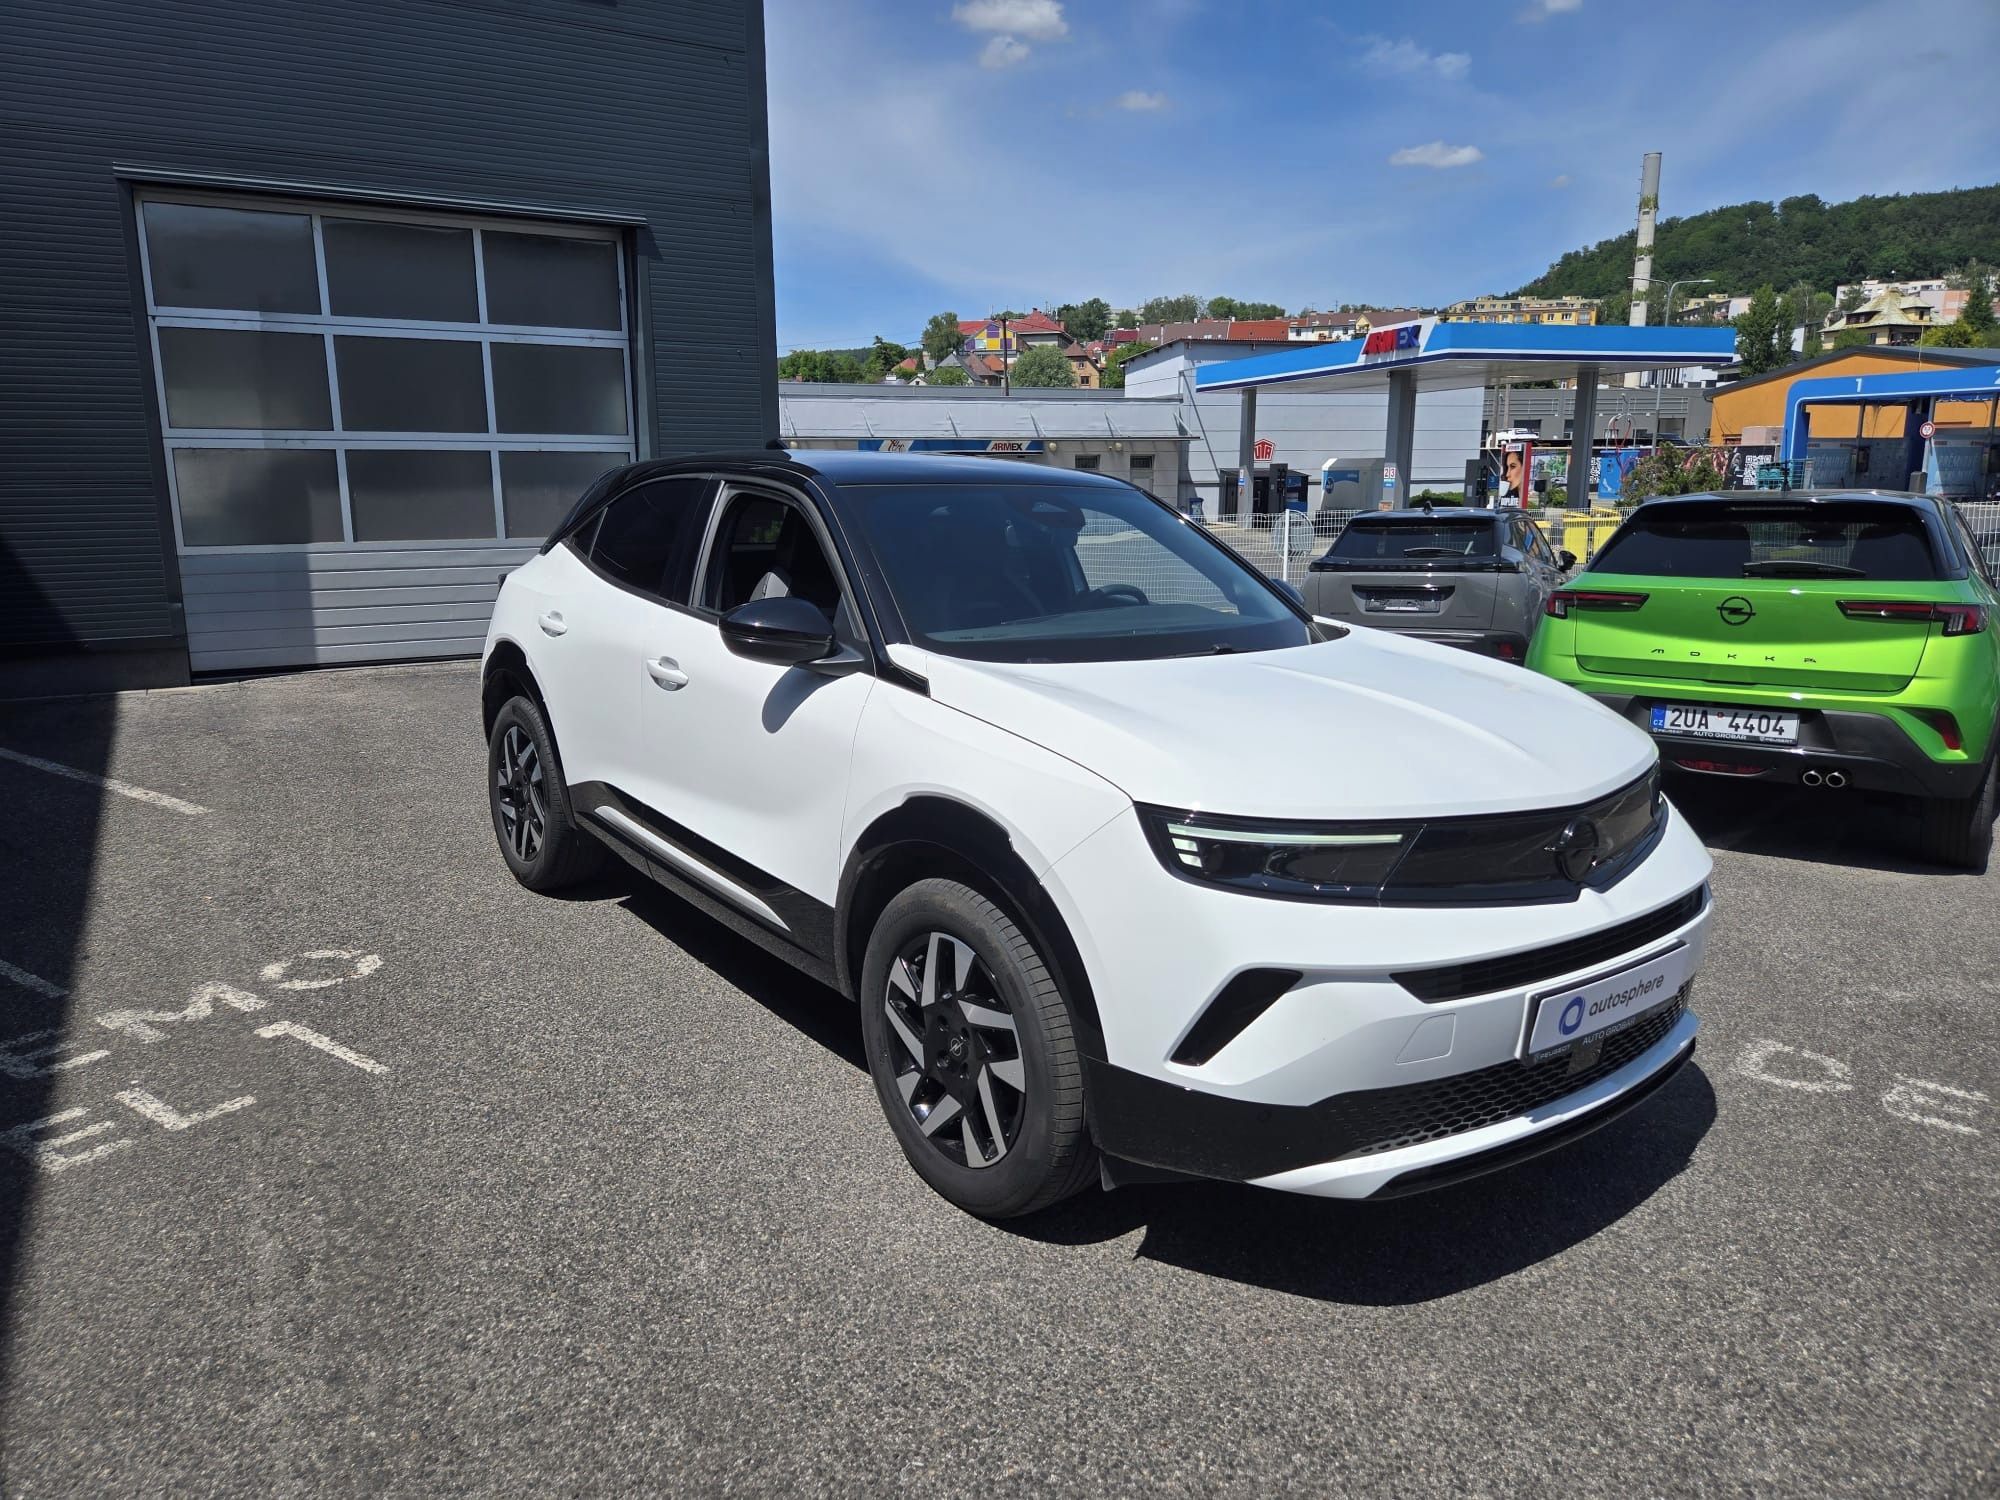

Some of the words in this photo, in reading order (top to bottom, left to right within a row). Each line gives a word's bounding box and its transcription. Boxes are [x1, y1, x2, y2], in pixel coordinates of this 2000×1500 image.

[1361, 325, 1422, 355] ARMEX
[1855, 378, 1863, 393] 1
[991, 442, 1023, 451] ARMEX
[1669, 708, 1709, 730] 2UA
[1728, 712, 1785, 736] 4404
[1588, 974, 1665, 1017] autosphere
[1582, 1030, 1605, 1046] AUTO
